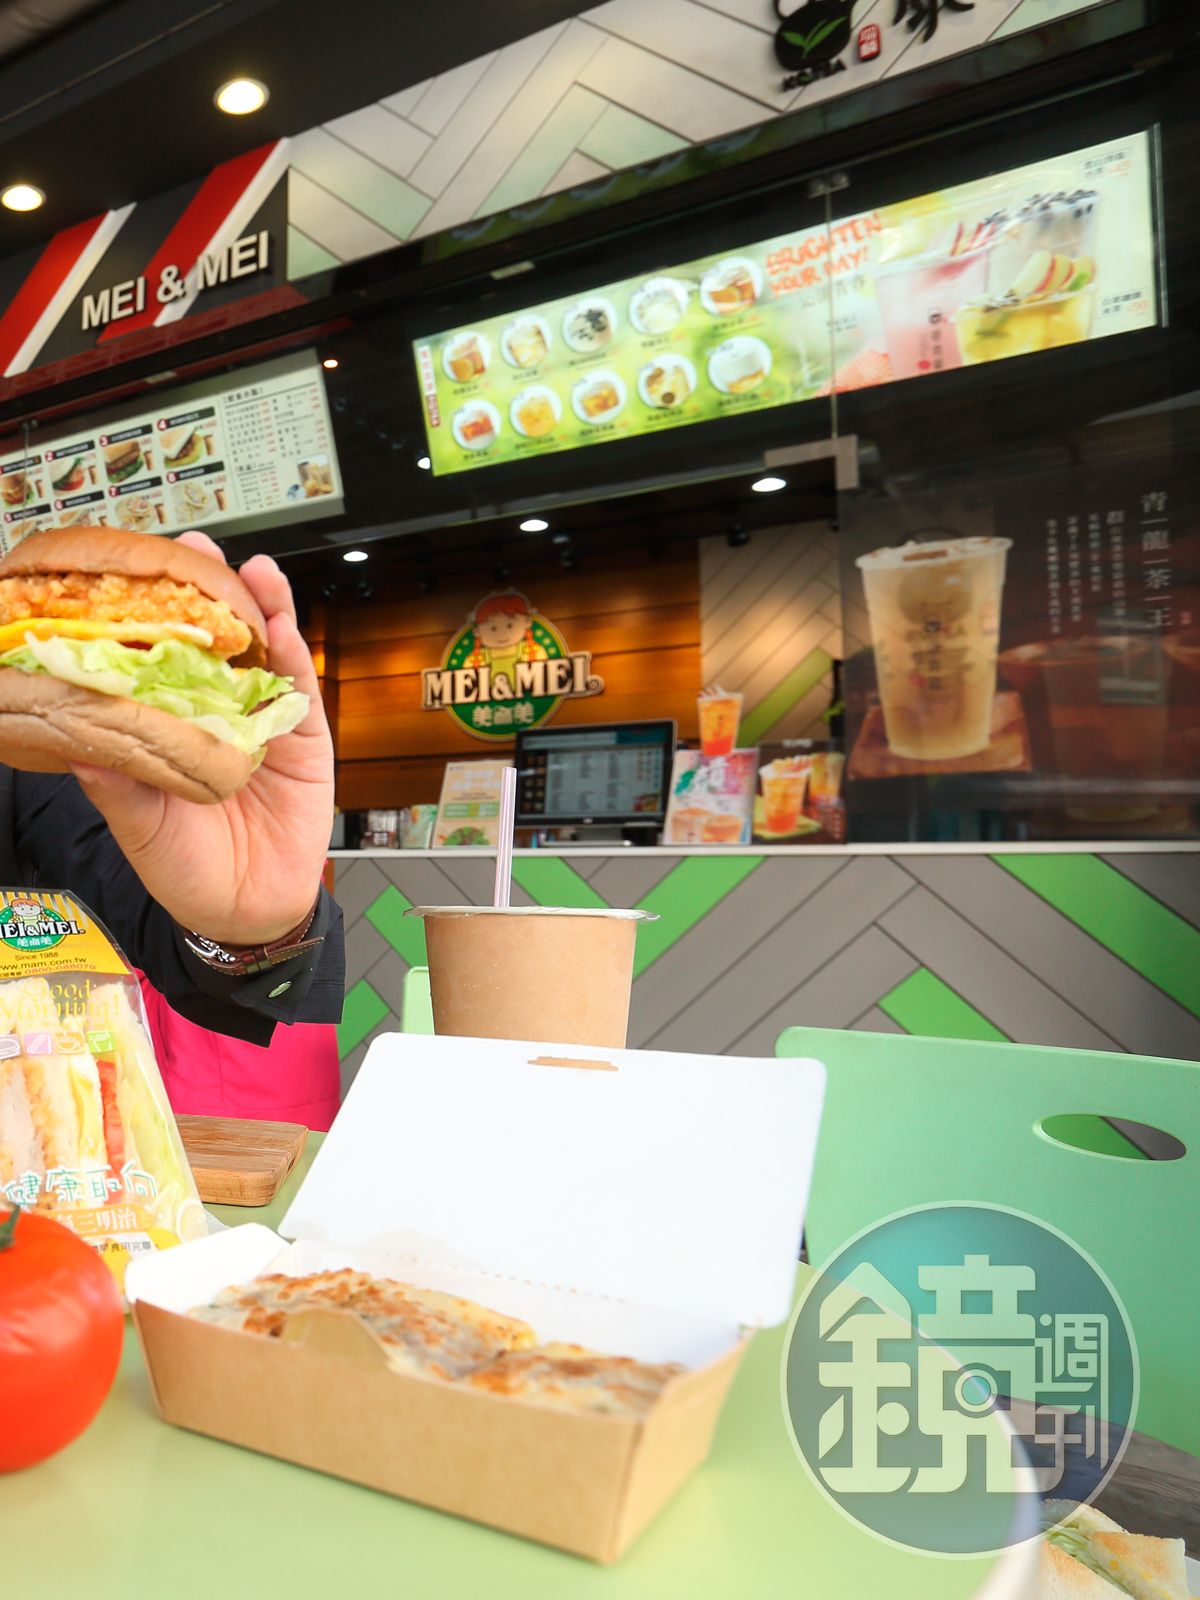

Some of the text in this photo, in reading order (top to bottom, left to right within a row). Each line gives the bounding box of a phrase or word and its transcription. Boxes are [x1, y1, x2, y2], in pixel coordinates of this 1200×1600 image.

[81, 229, 270, 331] MEI & MEI
[425, 656, 588, 707] MEI&MEI
[15, 953, 37, 962] Since
